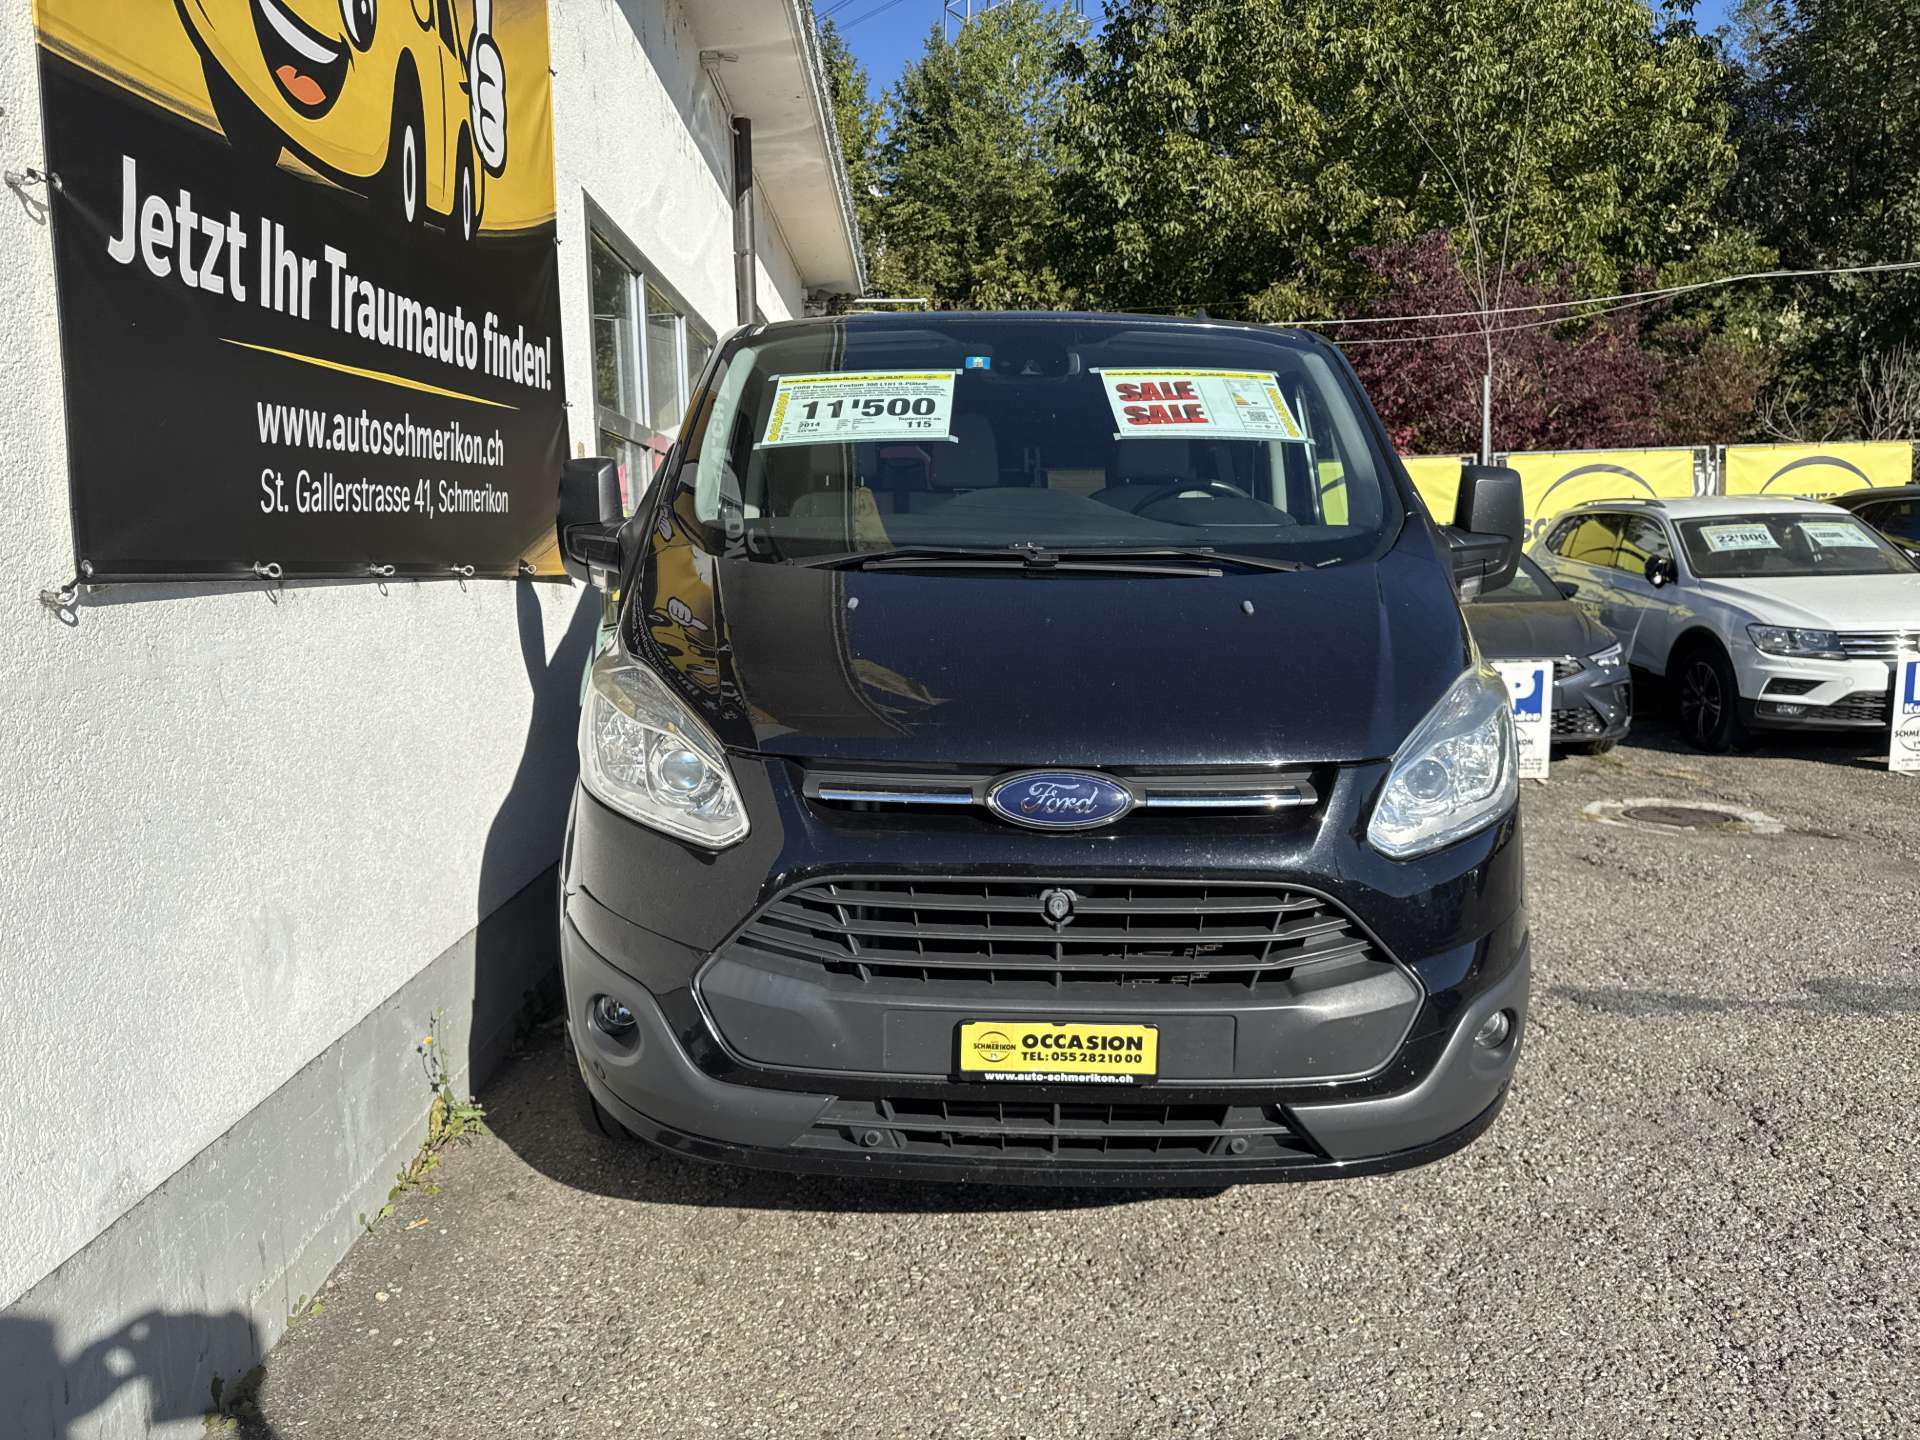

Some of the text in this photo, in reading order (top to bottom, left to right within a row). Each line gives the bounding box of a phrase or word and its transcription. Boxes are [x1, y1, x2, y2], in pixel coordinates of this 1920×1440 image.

[107, 154, 552, 391] Jetzt Ihr Traumauto finden!
[1115, 381, 1200, 402] SALE
[802, 397, 936, 420] 11'500
[1123, 403, 1209, 426] SALE
[257, 402, 504, 467] www.autoschmerikon.ch
[260, 468, 509, 519] St. Gallerstrasse 41, Schmerikon
[1020, 782, 1099, 814] Ford
[1022, 1034, 1143, 1051] OCCASION
[1022, 1052, 1049, 1062] TEL:
[1051, 1052, 1077, 1062] 055
[985, 1072, 1134, 1084] www.auto-schmerikon.ch
